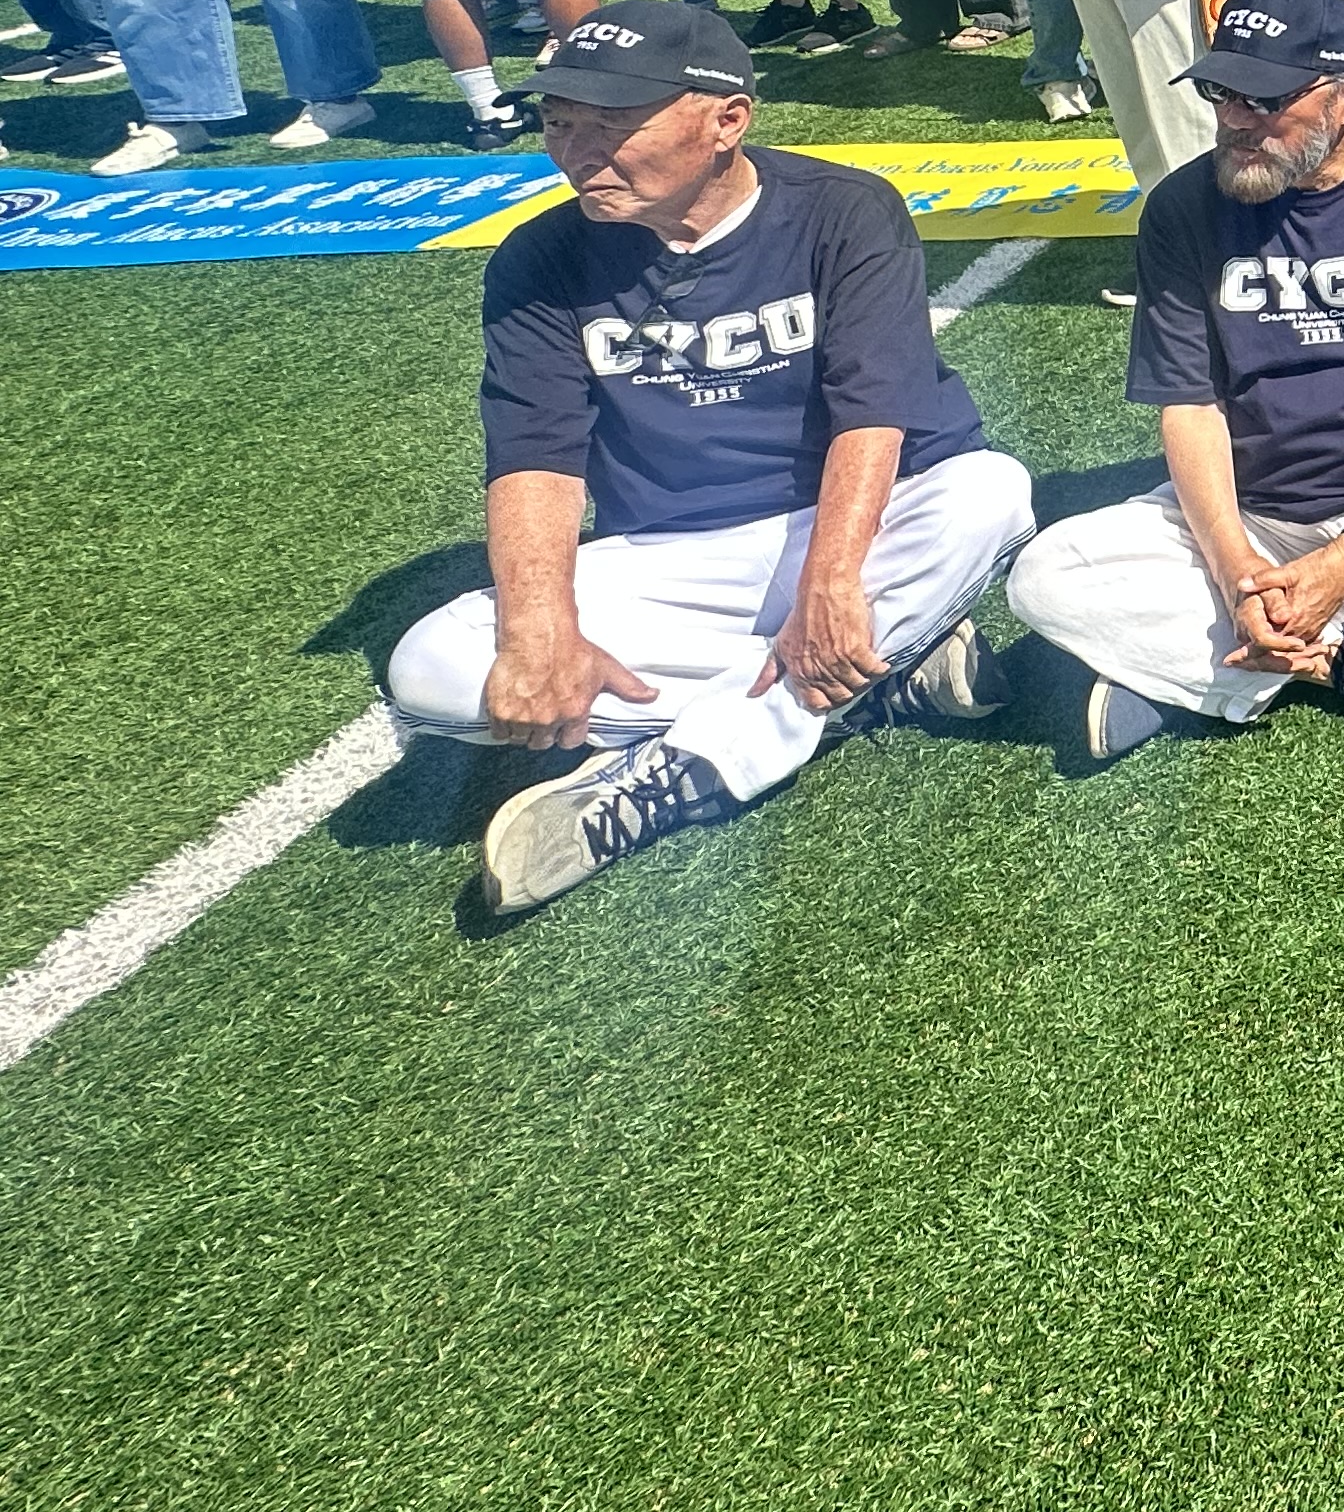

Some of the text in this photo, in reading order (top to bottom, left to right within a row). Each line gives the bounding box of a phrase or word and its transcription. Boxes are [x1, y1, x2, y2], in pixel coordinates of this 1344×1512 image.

[1223, 9, 1288, 38] CYCU
[91, 221, 246, 245] Abacus
[235, 212, 464, 238] Association
[582, 291, 817, 376] CYCU
[631, 359, 791, 385] CHUNG YUAN CHRISTIAN
[679, 377, 753, 391] UNIVERSITY
